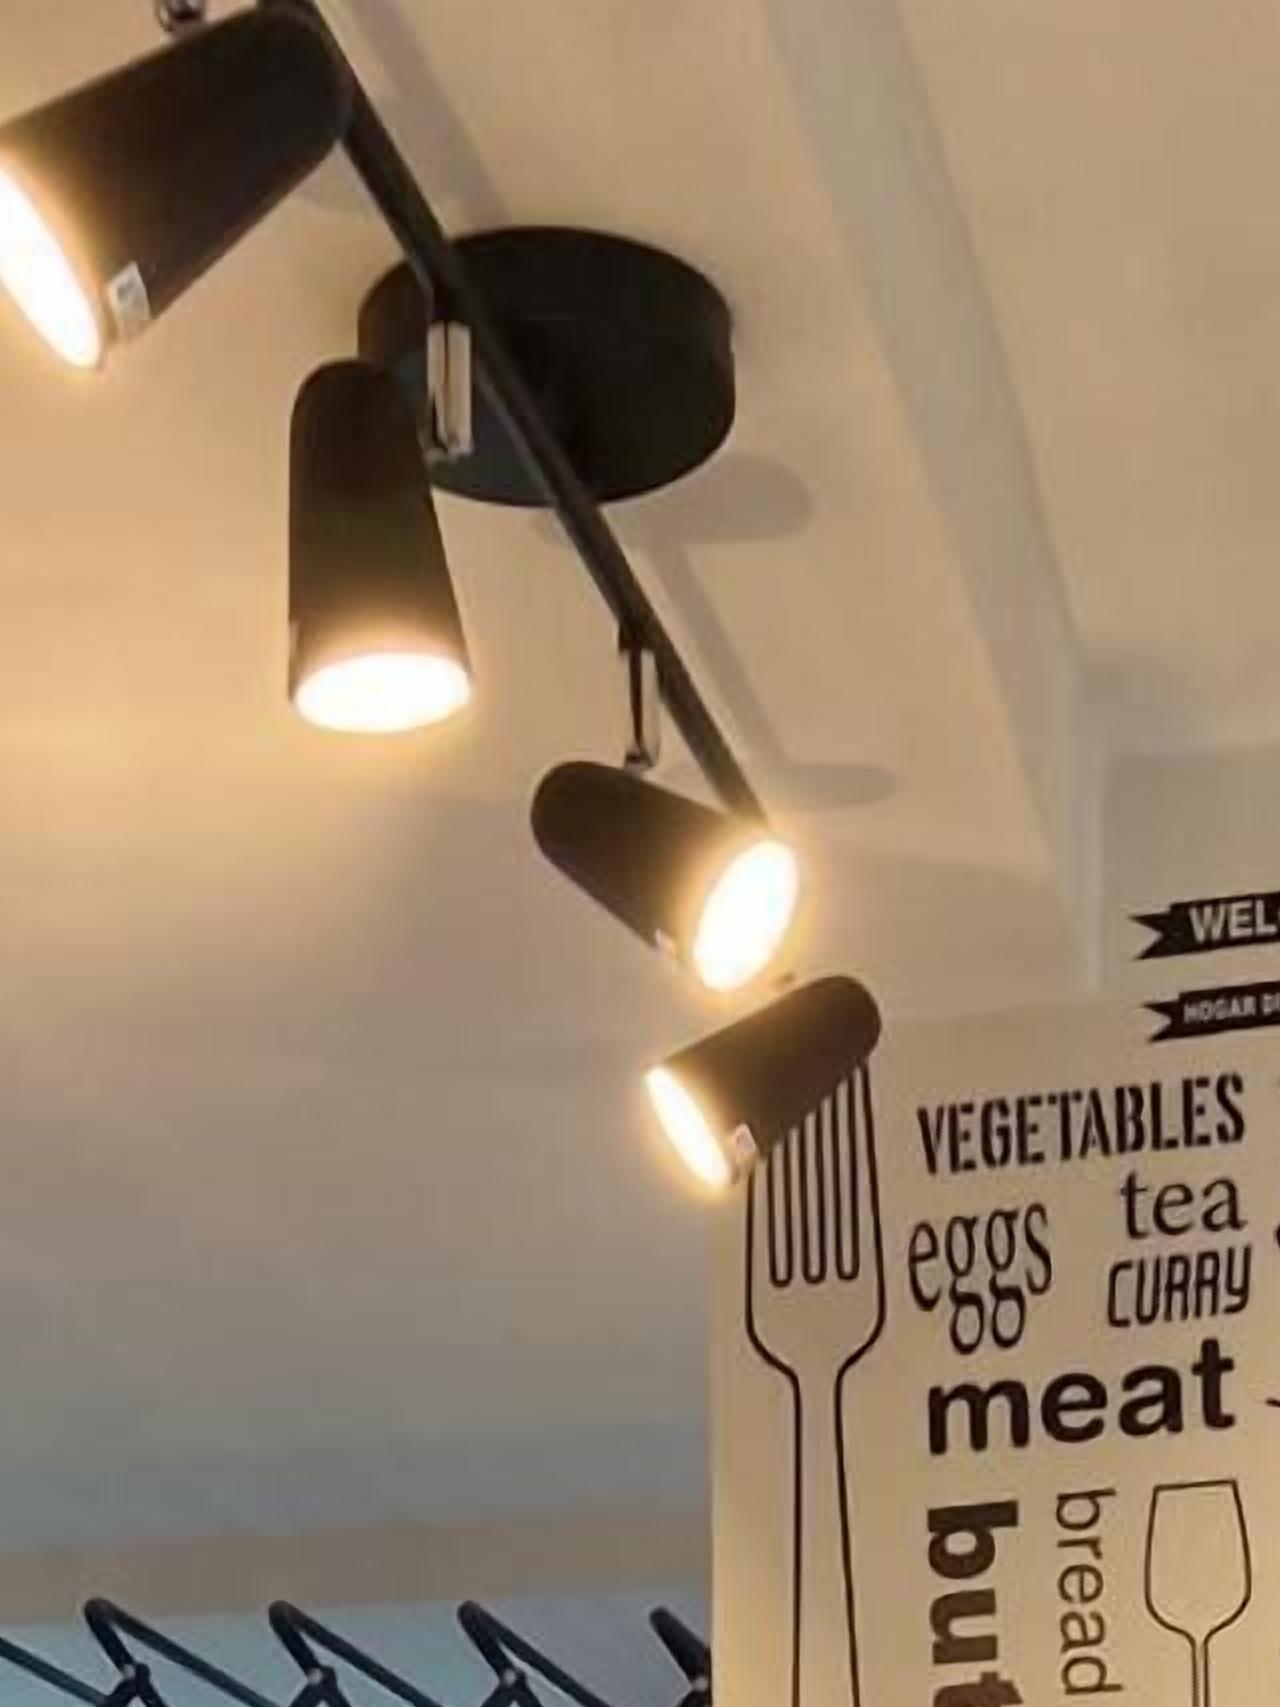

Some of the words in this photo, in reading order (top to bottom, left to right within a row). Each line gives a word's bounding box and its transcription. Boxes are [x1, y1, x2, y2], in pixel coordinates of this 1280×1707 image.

[1182, 996, 1257, 1025] HOGAR
[917, 1073, 1245, 1176] VEGETABLES
[1121, 1171, 1248, 1239] tea
[907, 1203, 1053, 1355] eggs
[1107, 1245, 1252, 1328] CURRY
[928, 1338, 1237, 1456] meat
[1055, 1488, 1124, 1695] bread
